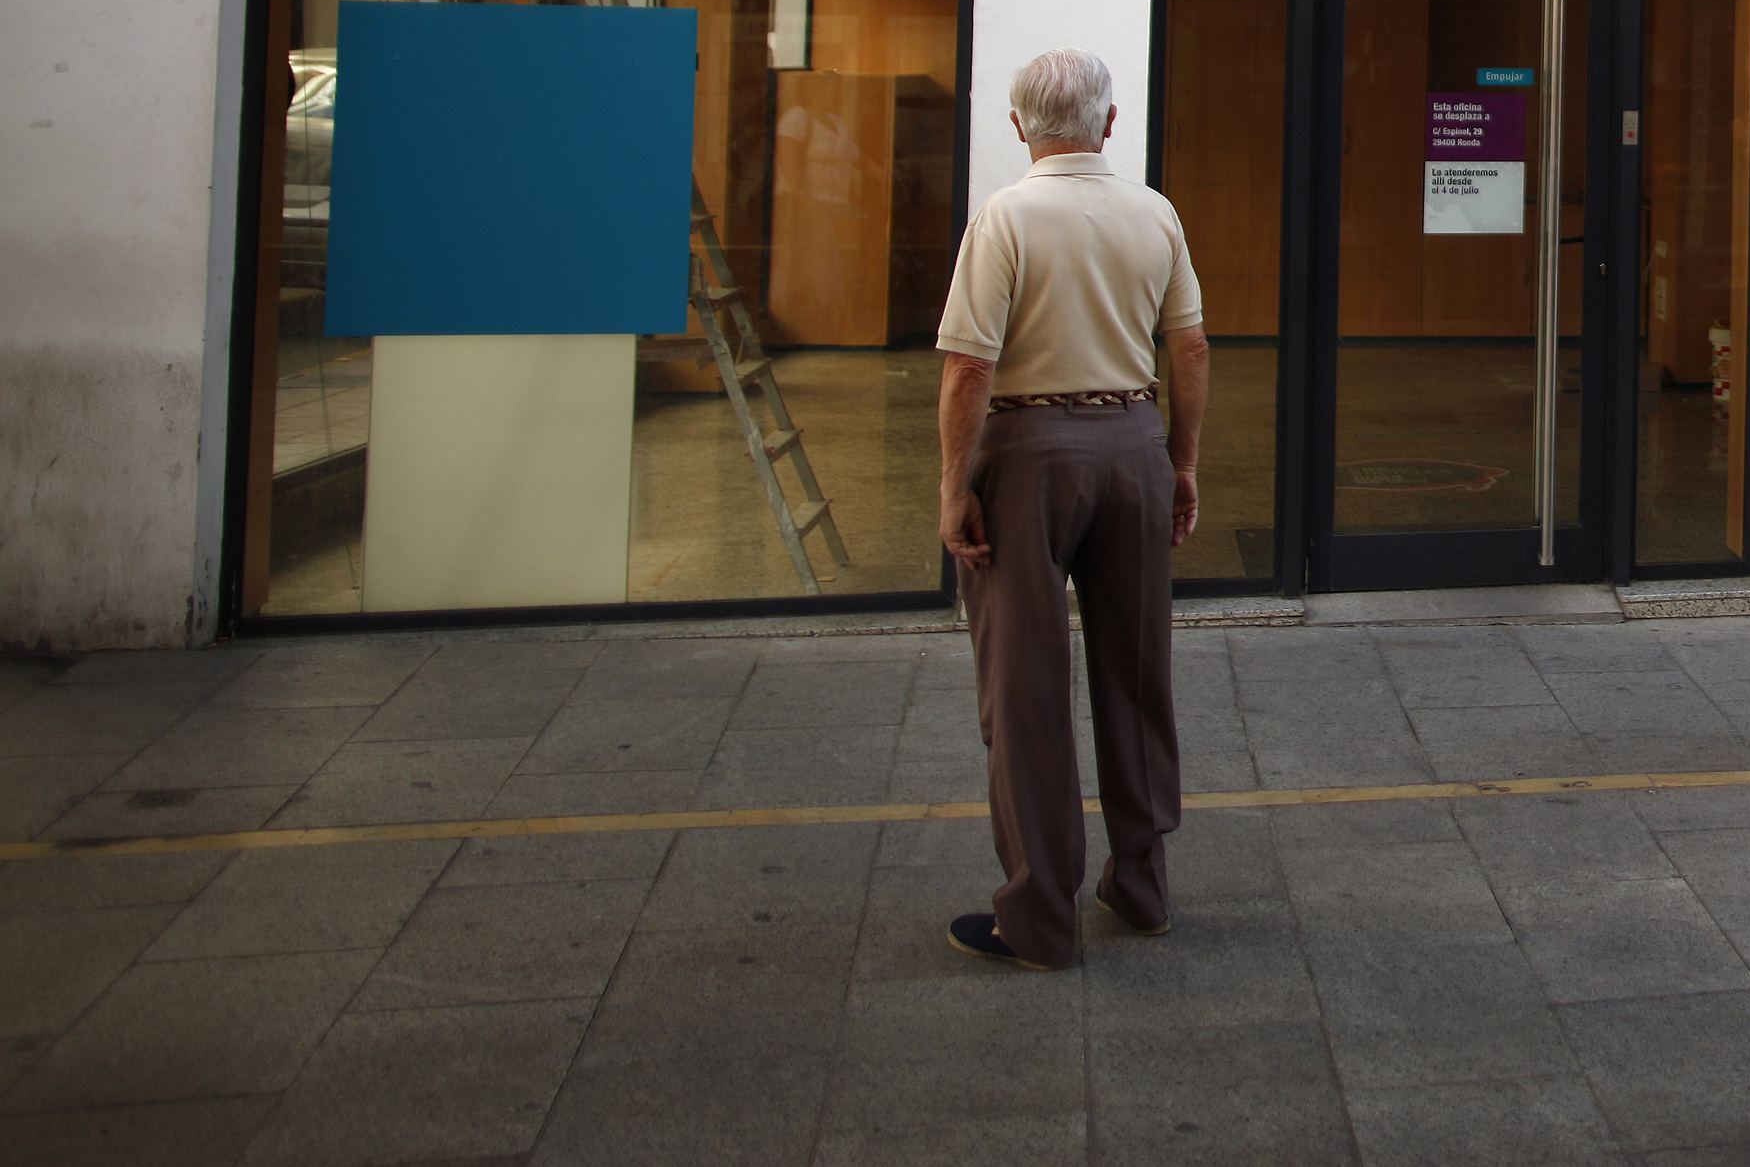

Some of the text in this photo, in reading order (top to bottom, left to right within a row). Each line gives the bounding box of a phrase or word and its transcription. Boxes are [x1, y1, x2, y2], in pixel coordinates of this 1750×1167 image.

[1485, 71, 1525, 83] Empujar
[1433, 102, 1482, 111] Esta oficina
[1445, 112, 1482, 122] desplaza
[1432, 127, 1483, 136] C/ Espinel, 29
[1431, 168, 1498, 177] Le atenderemos
[1447, 177, 1472, 185] desde
[1460, 186, 1479, 195] julio
